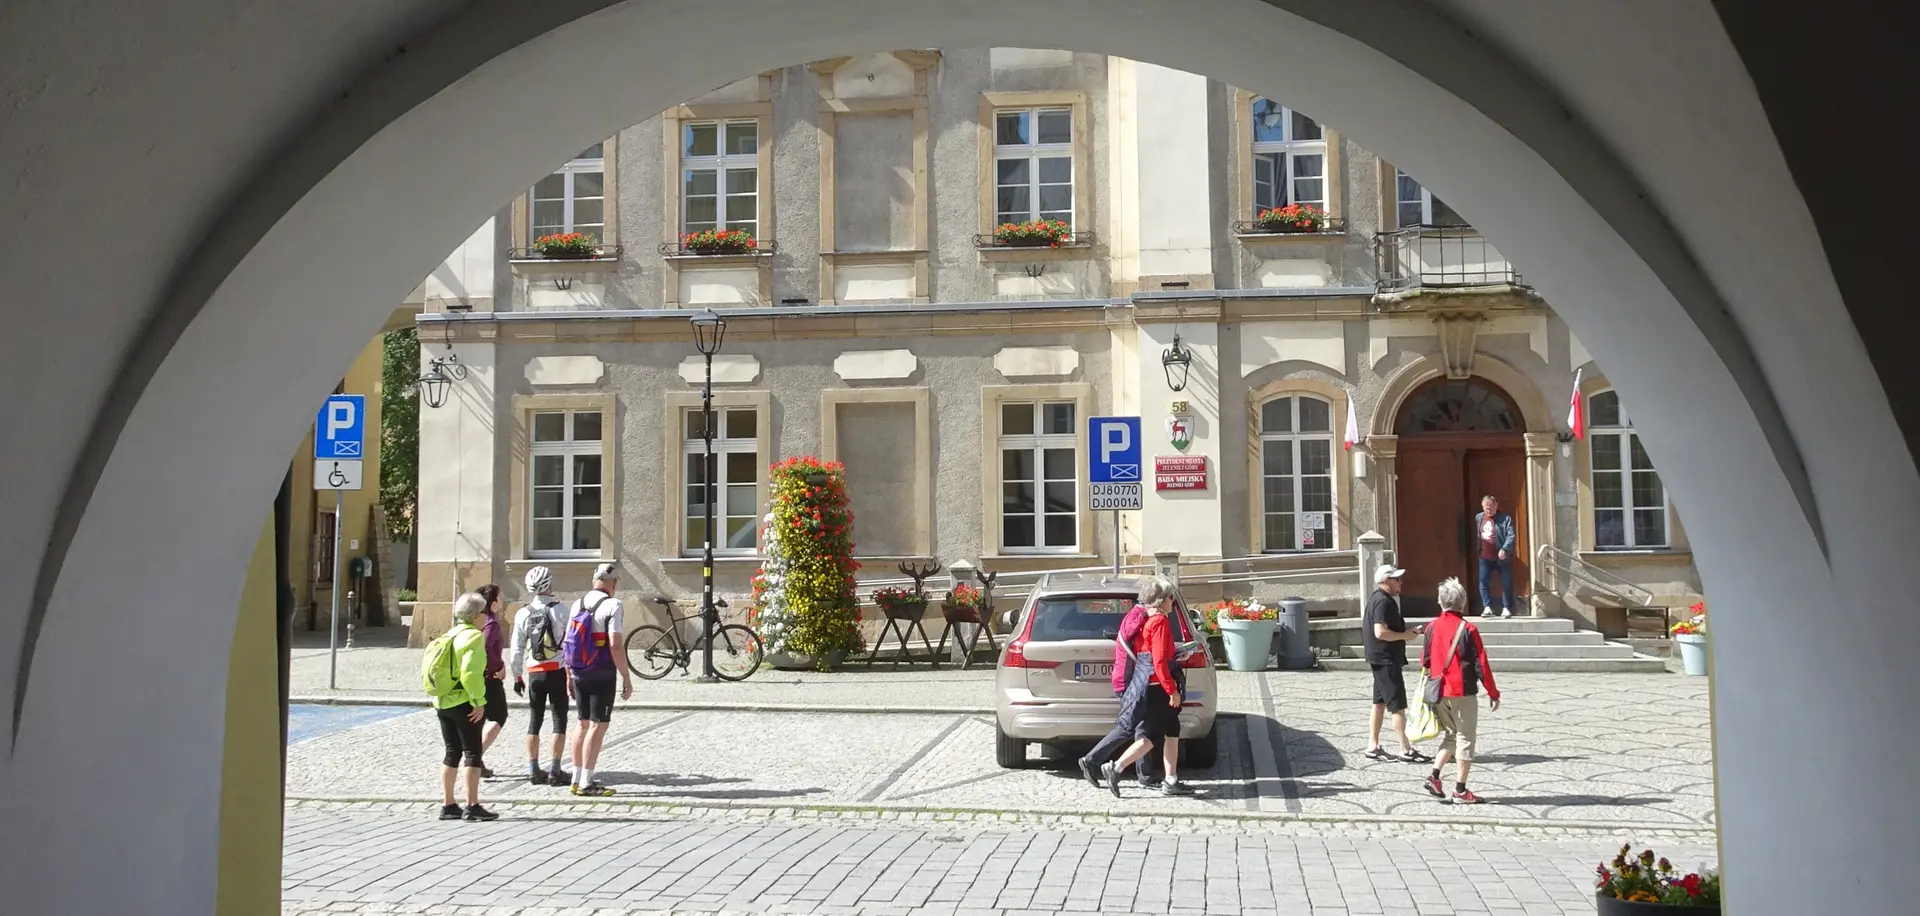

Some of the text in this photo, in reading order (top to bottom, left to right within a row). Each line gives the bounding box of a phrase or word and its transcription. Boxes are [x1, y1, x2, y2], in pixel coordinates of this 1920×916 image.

[1172, 401, 1187, 412] 58
[327, 401, 355, 440] P
[1101, 422, 1131, 463] P
[1093, 485, 1138, 495] DJ80770
[1093, 498, 1139, 508] DJ0001A
[1083, 664, 1113, 676] DJ 00
